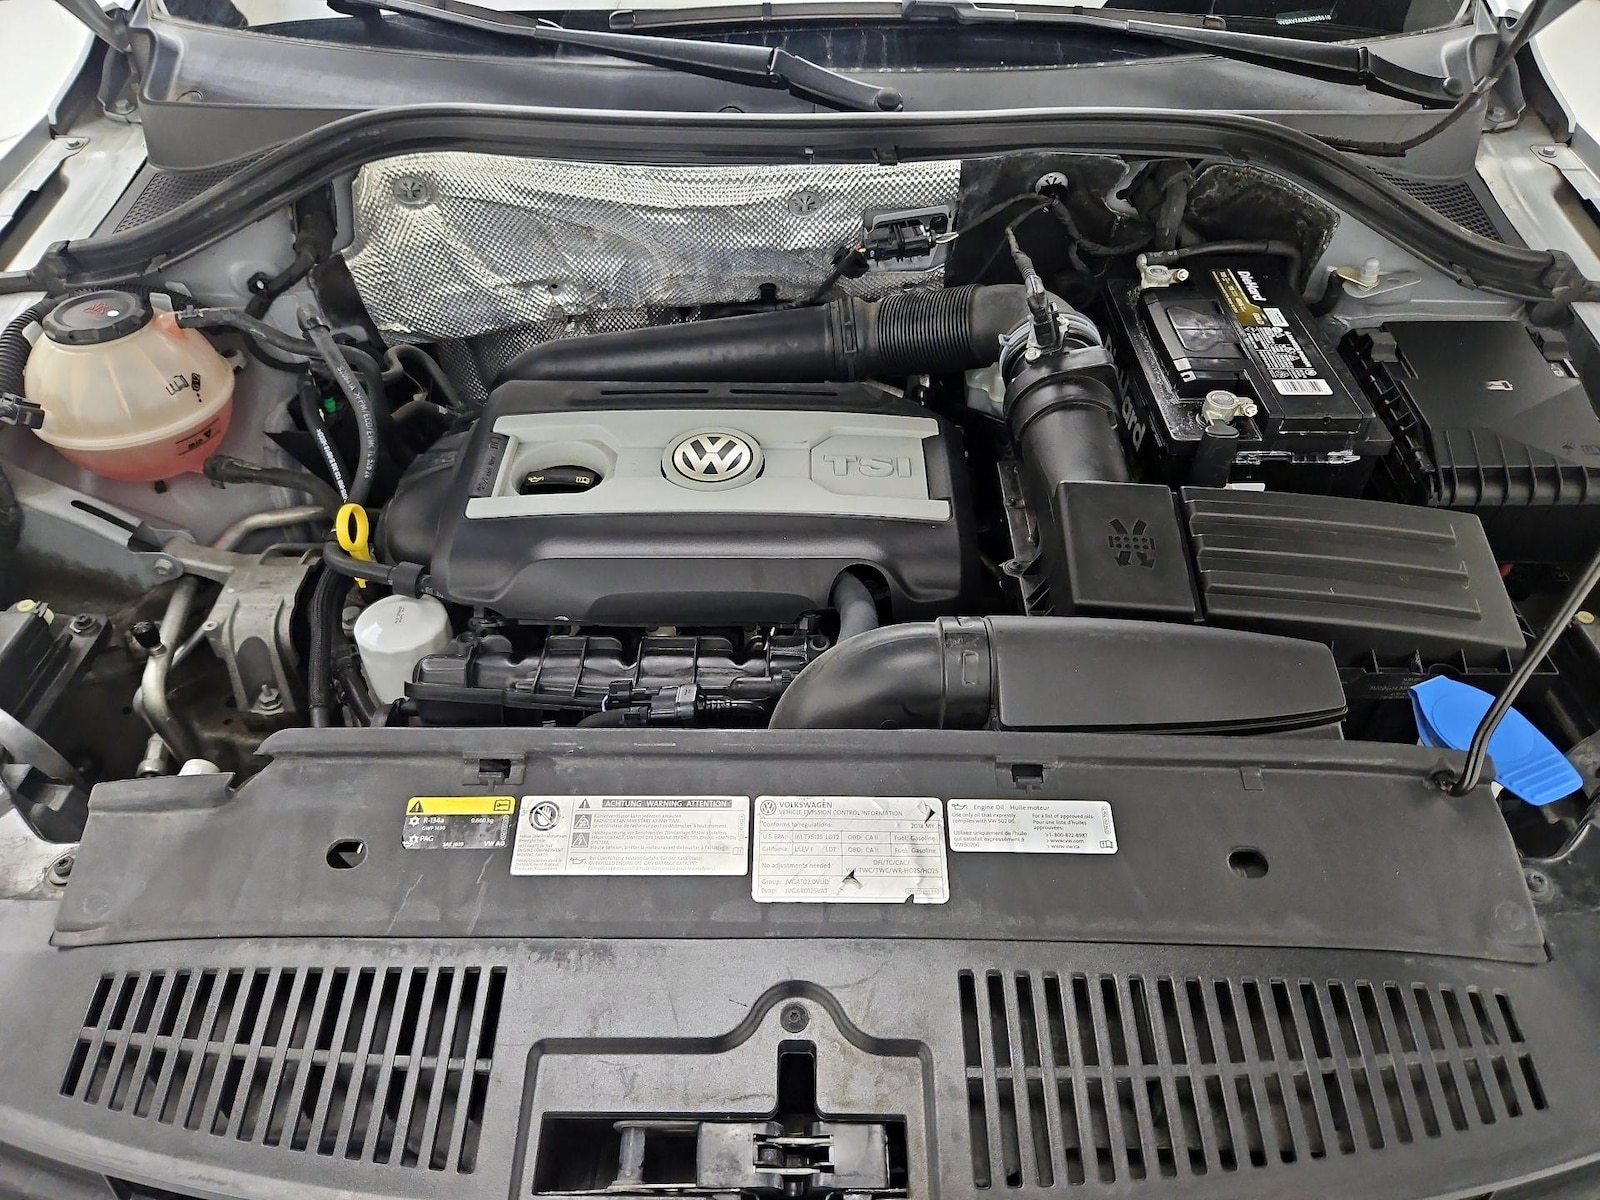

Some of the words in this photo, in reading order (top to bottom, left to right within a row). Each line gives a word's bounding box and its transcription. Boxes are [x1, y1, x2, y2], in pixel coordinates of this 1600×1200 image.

[1237, 270, 1266, 302] DieHard
[824, 455, 912, 478] TSI
[686, 800, 727, 808] ATTENTION
[974, 804, 994, 812] Engine
